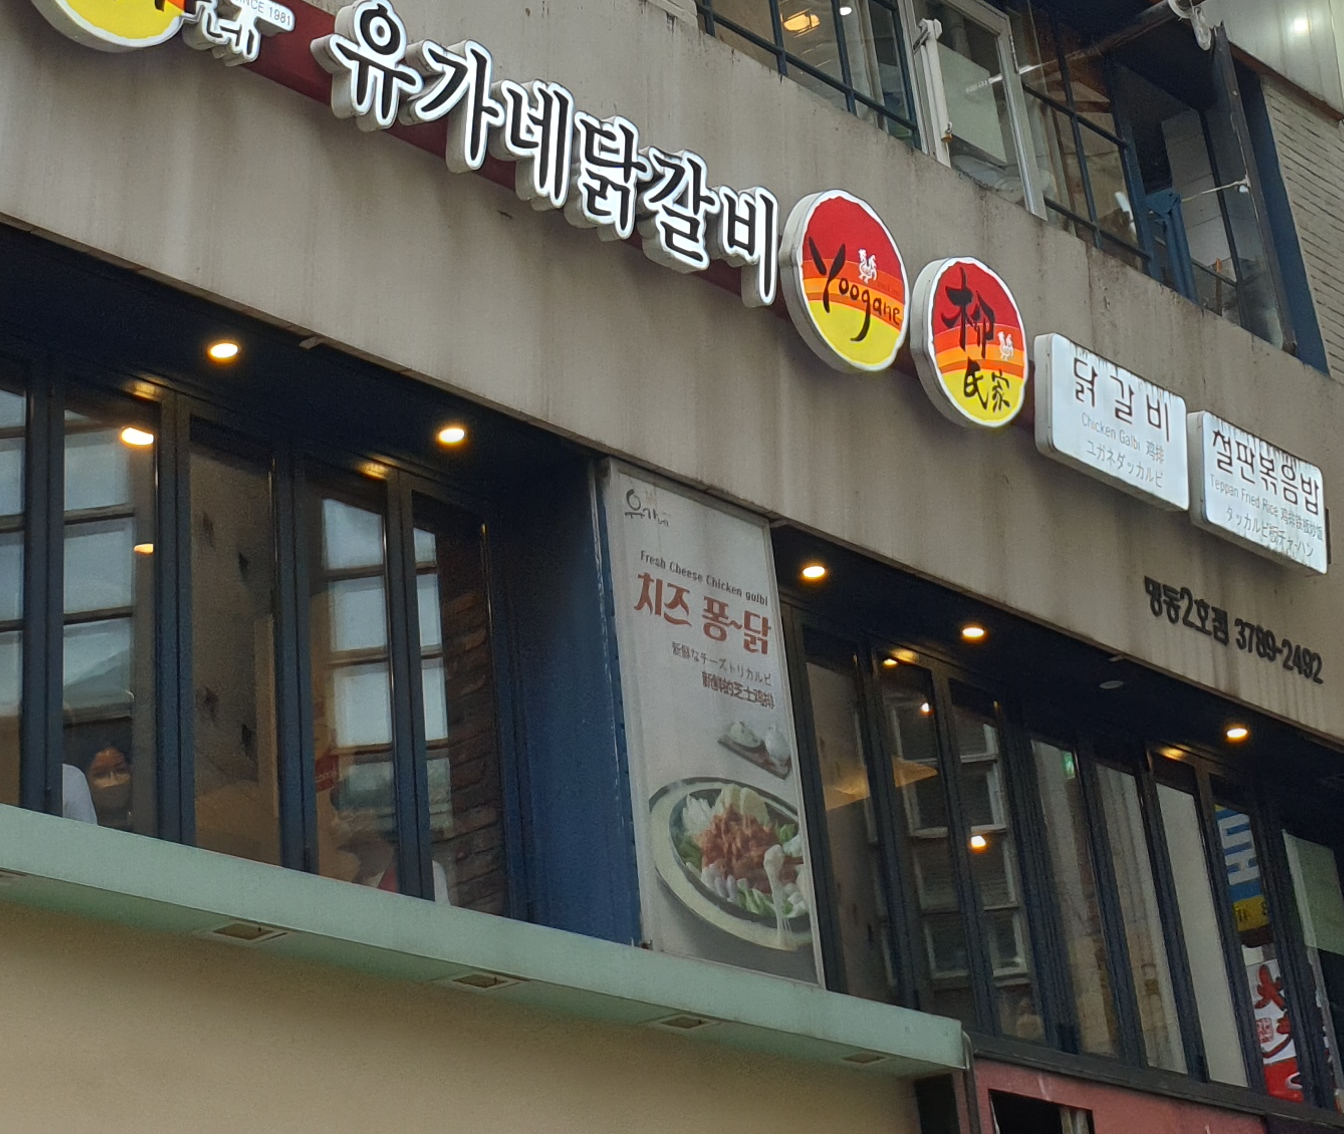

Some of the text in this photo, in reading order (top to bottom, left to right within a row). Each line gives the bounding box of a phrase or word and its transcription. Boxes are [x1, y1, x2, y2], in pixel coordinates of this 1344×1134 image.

[267, 3, 292, 26] 1981
[808, 235, 901, 343] Yoogane
[1073, 356, 1170, 443] 닭갈비
[1081, 411, 1142, 453] Chicken Galbi
[1209, 473, 1239, 500] Teppan
[1212, 428, 1320, 516] 철판볶음밥
[633, 571, 693, 628] 치즈
[640, 549, 666, 570] Fresh
[705, 574, 743, 598] Chicken
[1143, 574, 1230, 647] 명동2호점
[1234, 617, 1324, 685] 3789-2492
